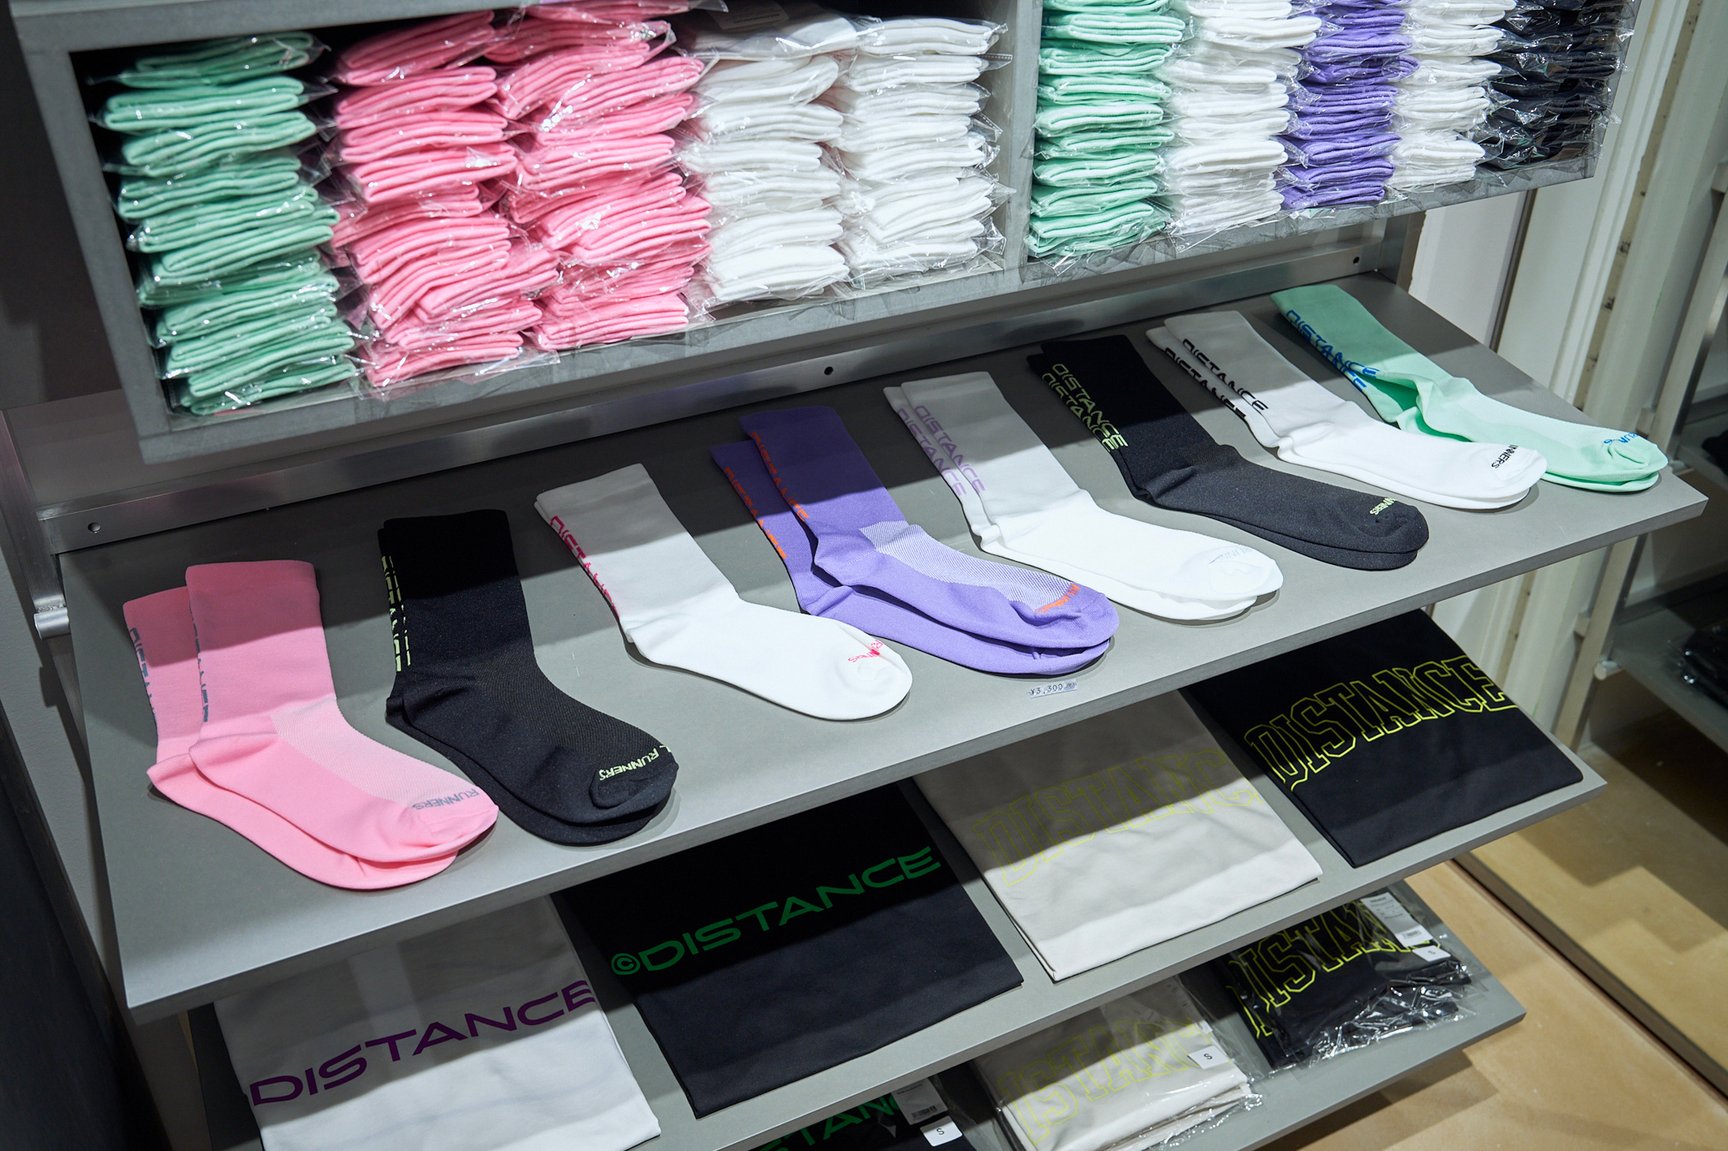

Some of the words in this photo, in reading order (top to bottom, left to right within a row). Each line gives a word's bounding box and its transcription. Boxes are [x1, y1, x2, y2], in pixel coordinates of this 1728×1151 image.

[1052, 363, 1128, 448] DISTANCE
[599, 748, 660, 781] RUNNERS
[1244, 655, 1518, 792] DISTANCE
[412, 788, 480, 810] RUNNERS
[971, 747, 1262, 887] DISTANC
[249, 980, 596, 1107] DISTANCE
[936, 1127, 945, 1136] S
